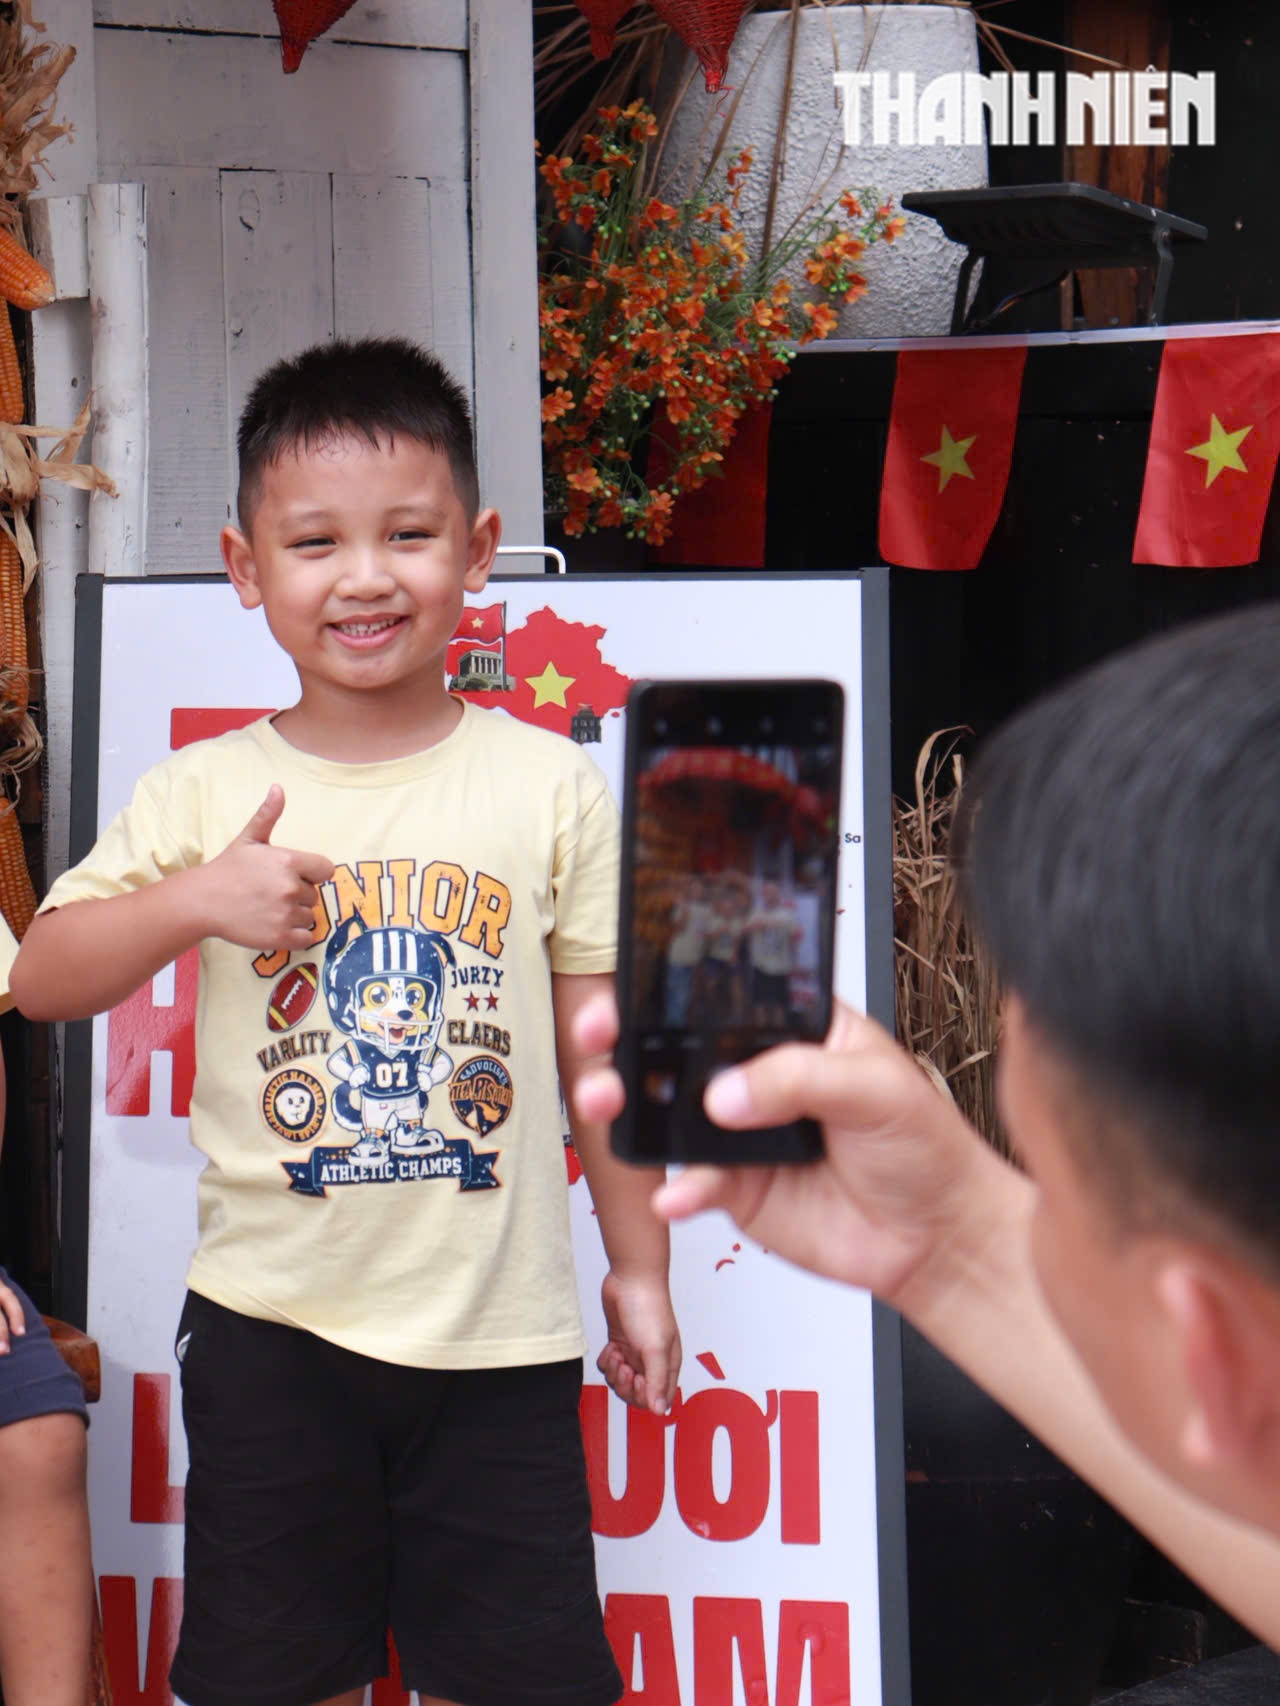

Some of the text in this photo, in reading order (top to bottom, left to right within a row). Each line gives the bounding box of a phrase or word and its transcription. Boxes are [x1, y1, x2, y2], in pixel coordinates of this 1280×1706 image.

[451, 965, 505, 988] JURZY
[256, 1030, 333, 1074] VARLITY
[375, 1061, 410, 1089] 07
[320, 1157, 463, 1183] ATHLETIC CHAMPS
[602, 1593, 851, 1706] AM
